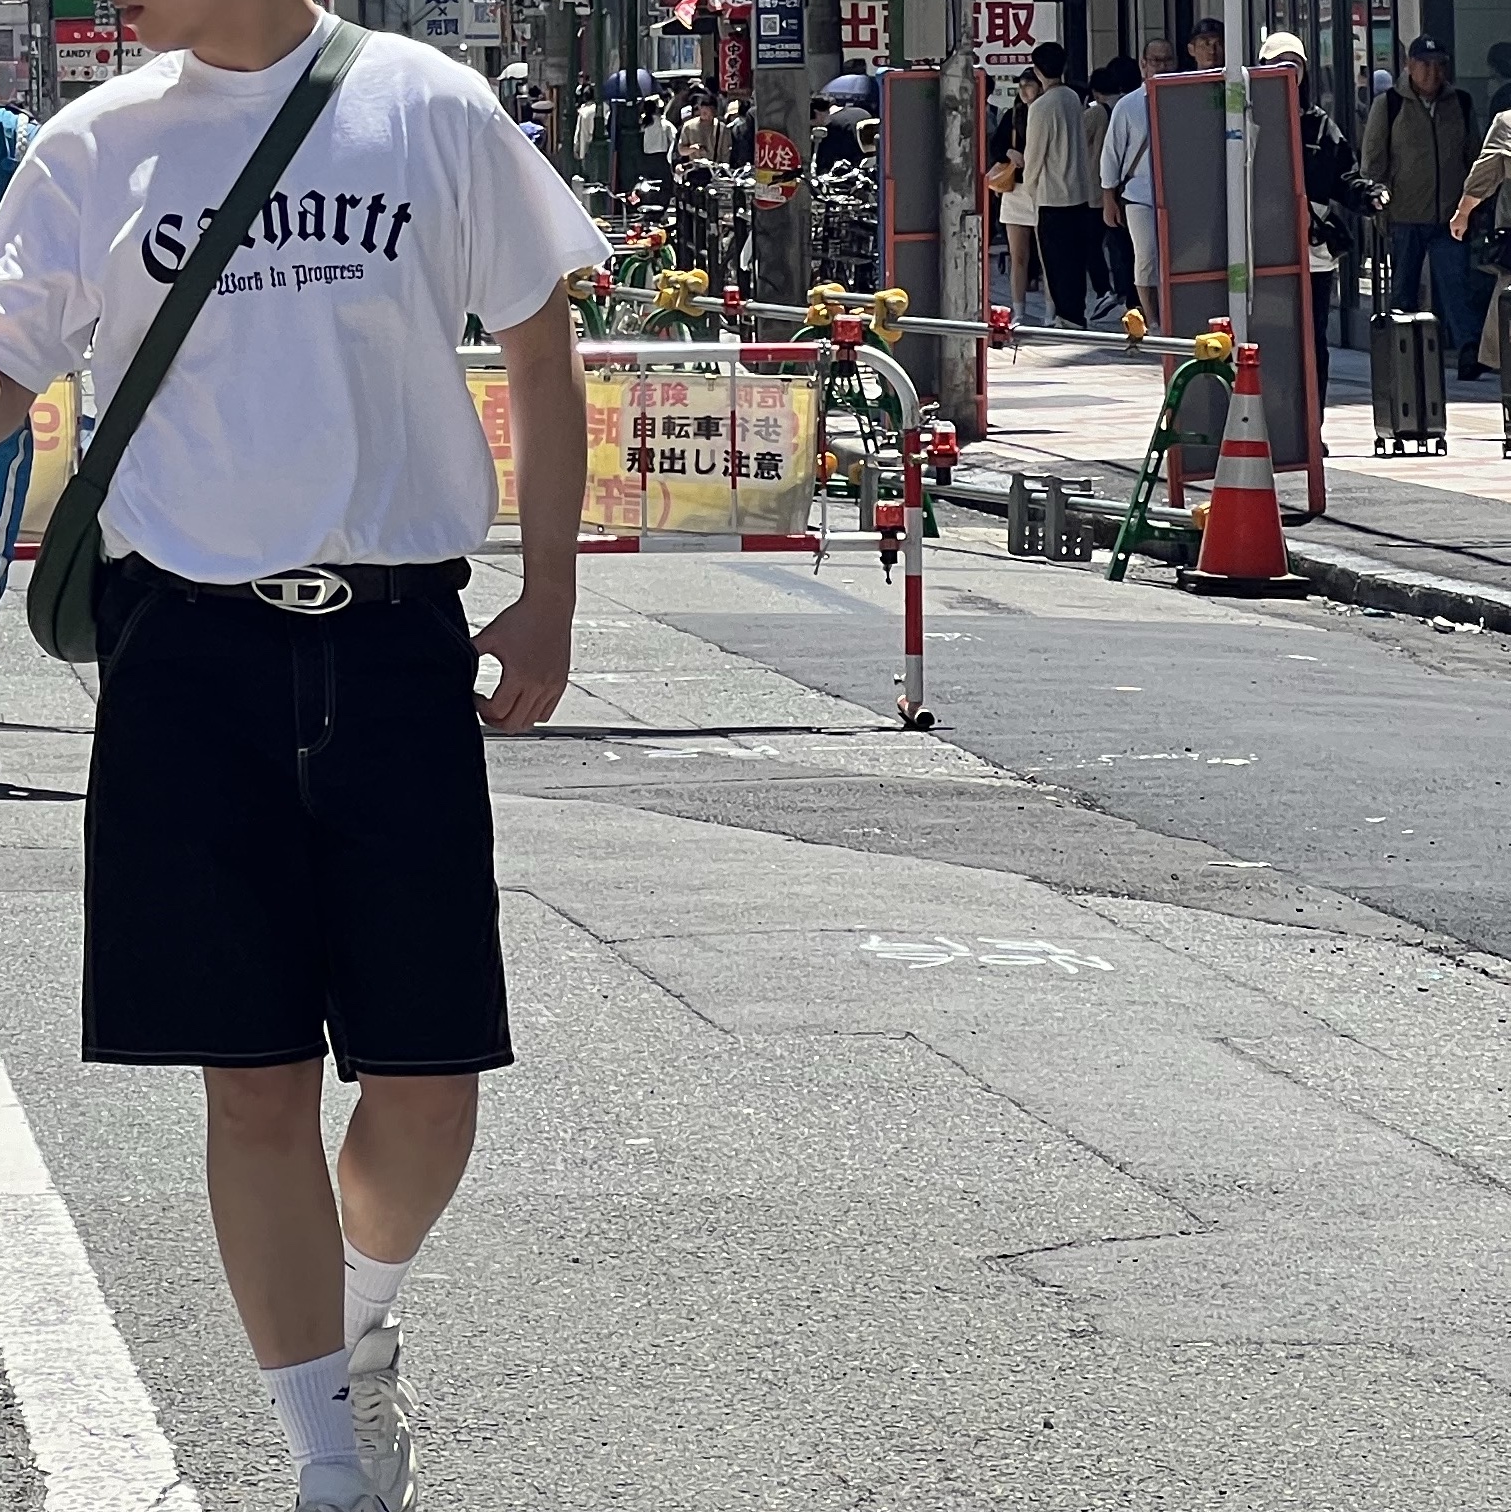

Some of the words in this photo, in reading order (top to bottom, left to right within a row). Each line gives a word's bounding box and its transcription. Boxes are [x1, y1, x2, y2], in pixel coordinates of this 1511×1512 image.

[427, 18, 459, 35] 売買
[59, 49, 92, 58] CANDY
[113, 47, 143, 58] APLE
[142, 189, 412, 284] Chartt
[214, 272, 263, 296] Work
[269, 265, 287, 288] In
[292, 263, 364, 293] Progress
[628, 382, 690, 408] 危険
[632, 415, 723, 441] 自転車
[626, 446, 785, 481] 飛出し注意
